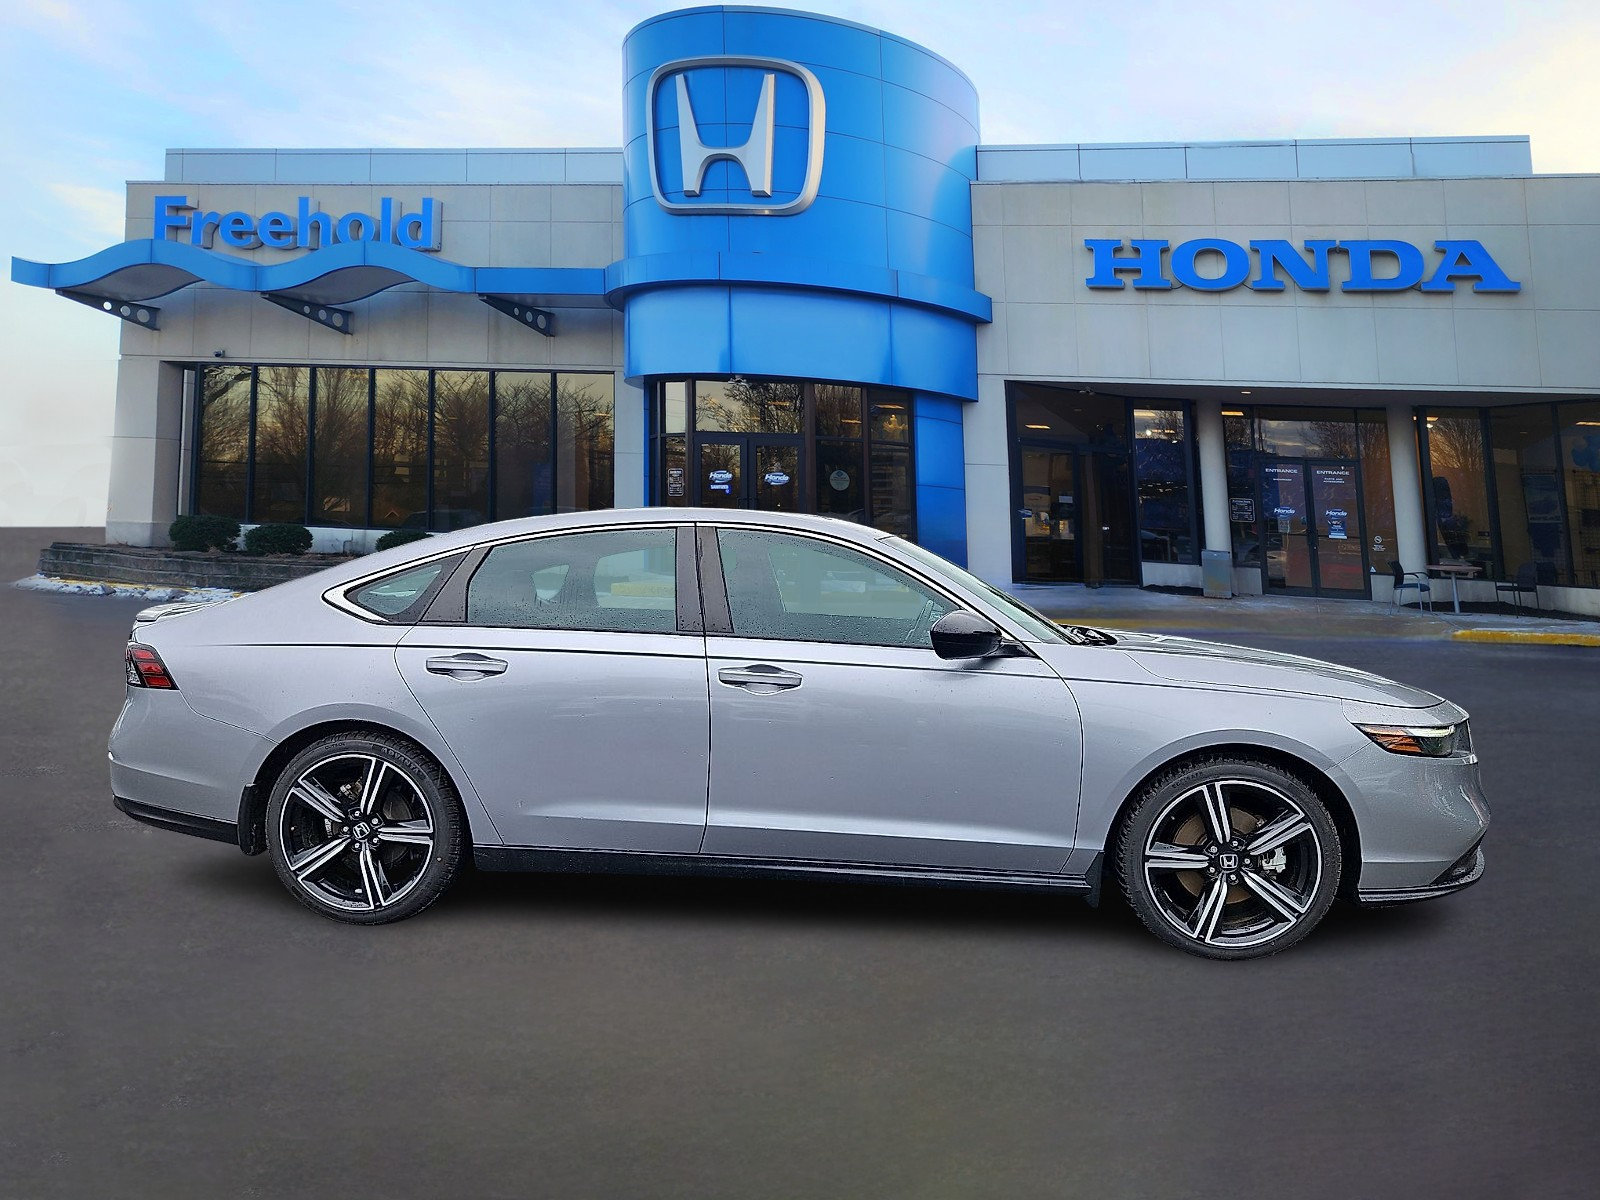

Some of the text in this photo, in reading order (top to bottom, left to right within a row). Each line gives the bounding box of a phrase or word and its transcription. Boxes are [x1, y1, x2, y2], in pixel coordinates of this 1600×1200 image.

[153, 195, 437, 250] Freehold
[1084, 238, 1521, 292] HONDA
[709, 472, 733, 480] Honda
[764, 473, 789, 481] Honda
[1274, 507, 1295, 515] Honda
[1325, 509, 1347, 517] Honda
